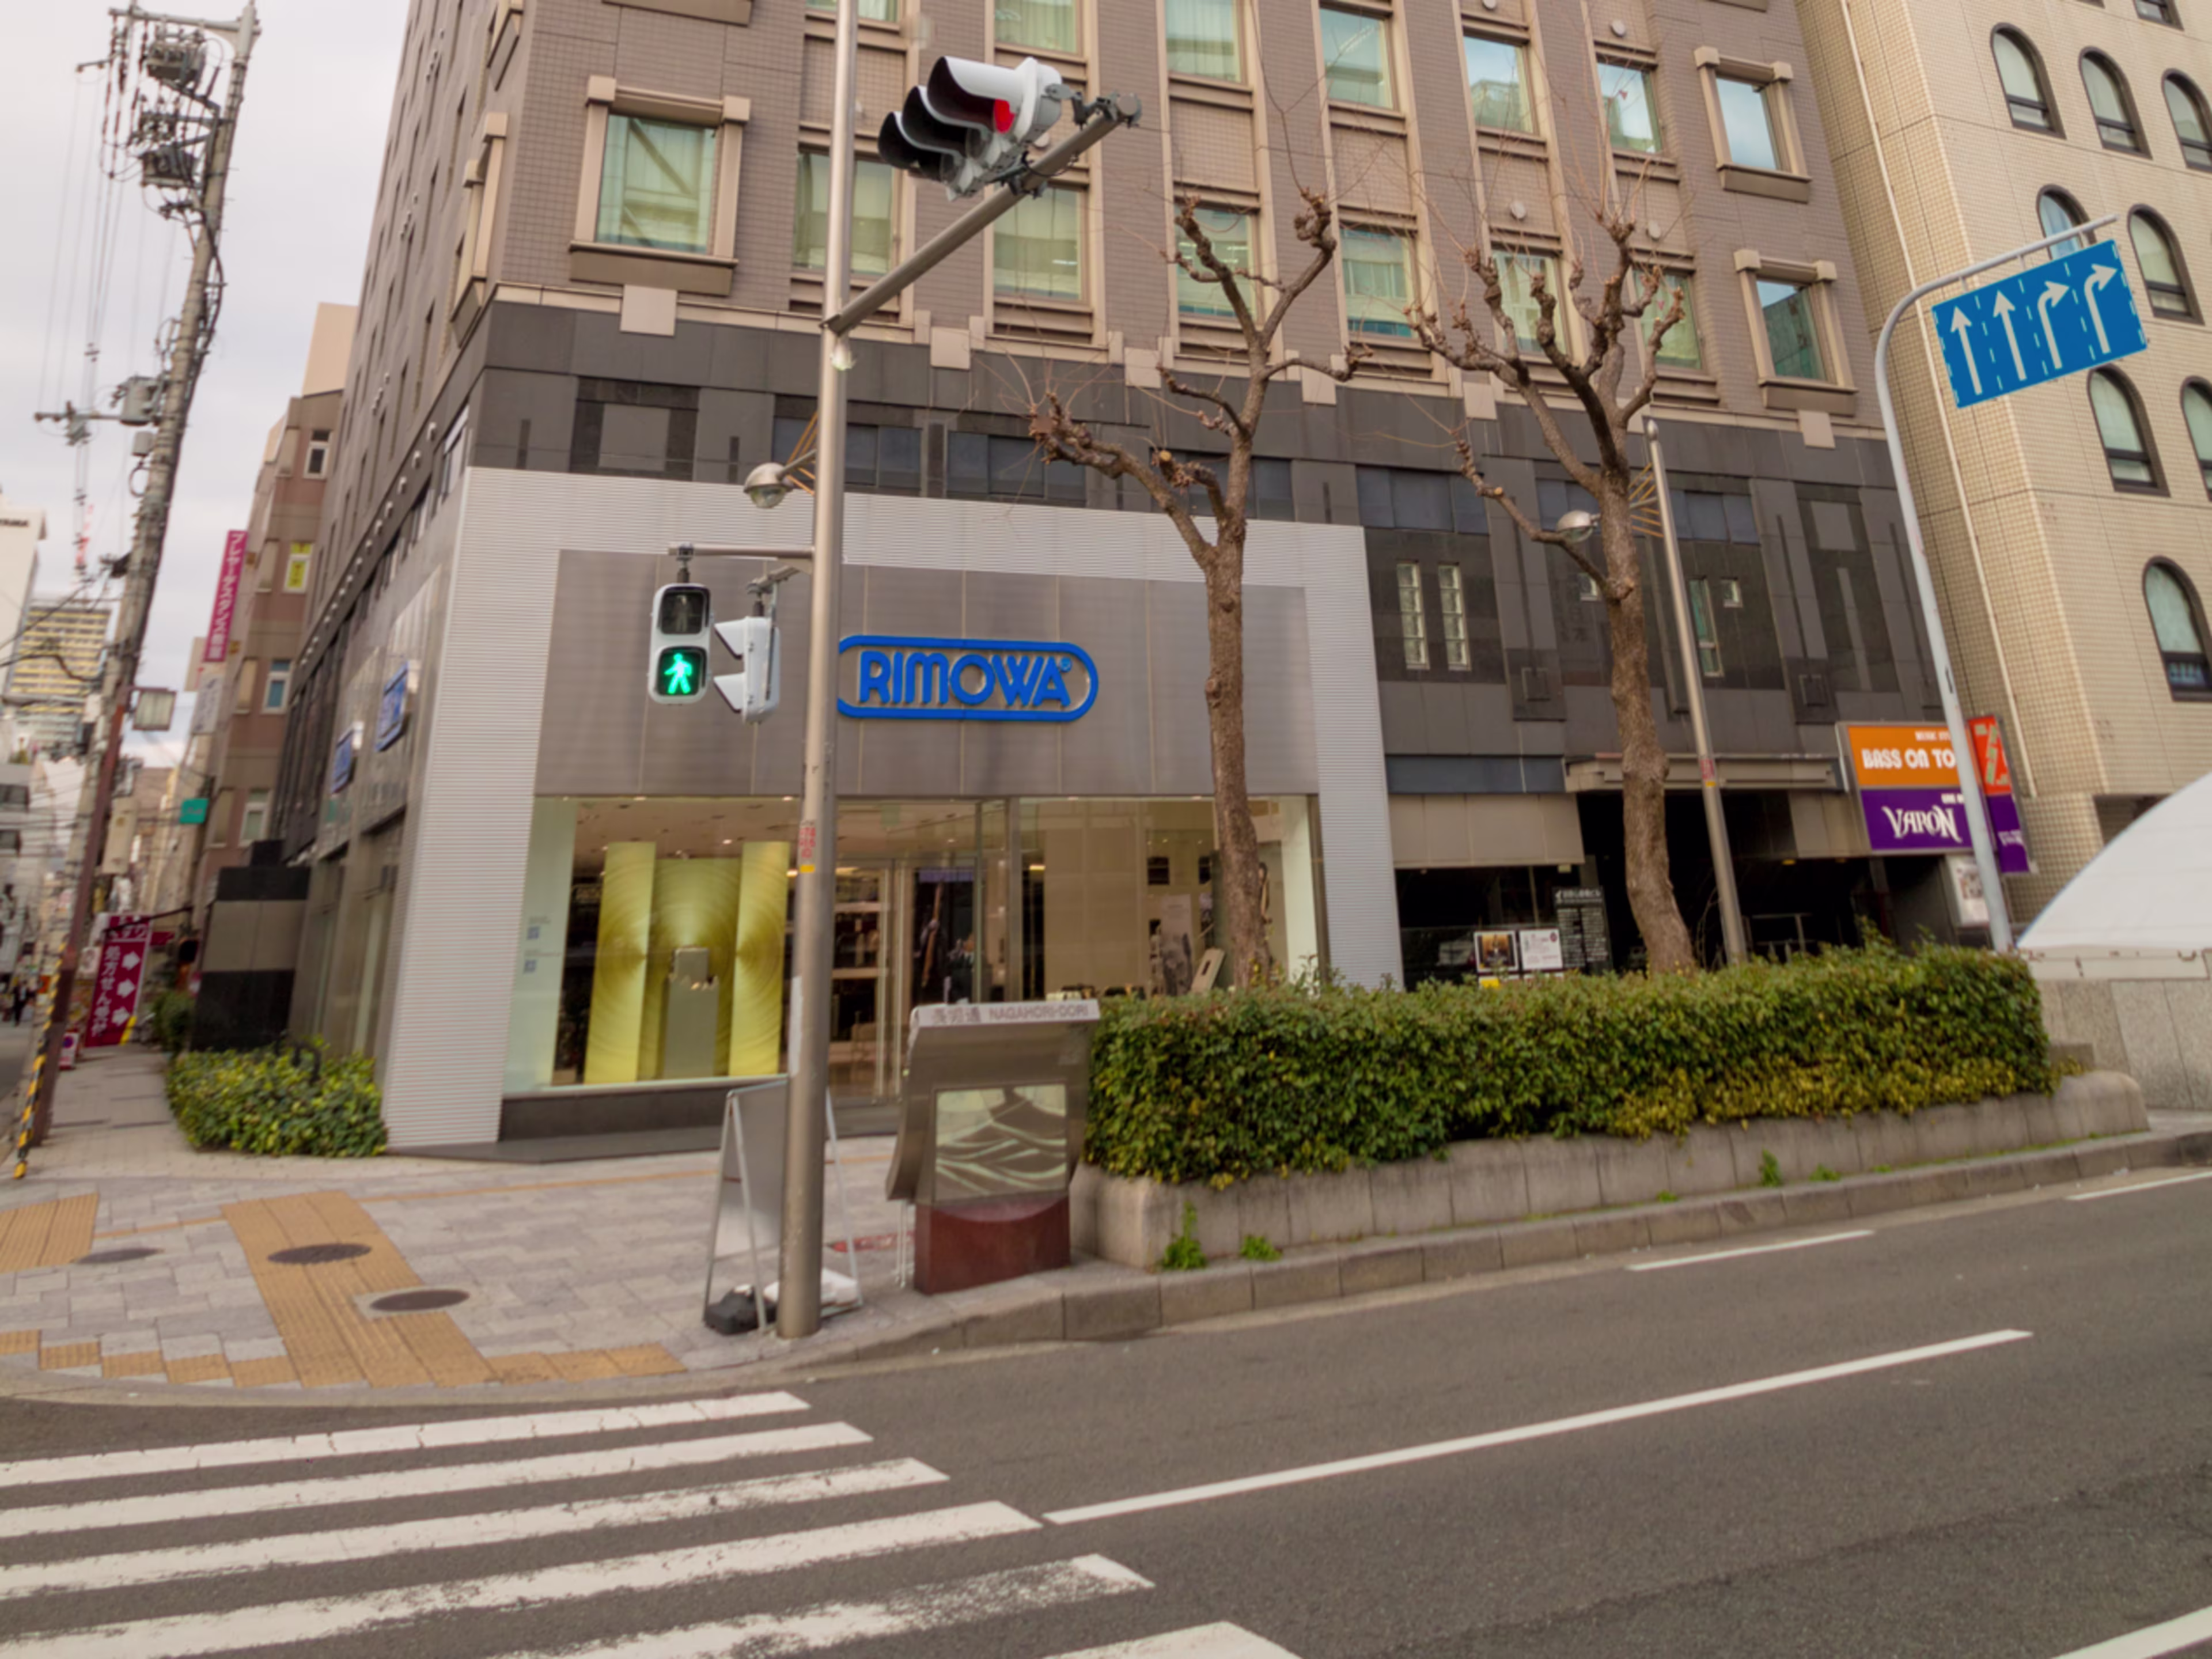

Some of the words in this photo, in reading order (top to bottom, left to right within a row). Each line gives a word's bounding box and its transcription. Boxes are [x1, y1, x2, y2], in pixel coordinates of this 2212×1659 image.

[859, 650, 1071, 707] RIMOWA
[1861, 748, 1903, 769] BASS
[1931, 749, 1956, 769] TO
[1881, 805, 1963, 843] VARON
